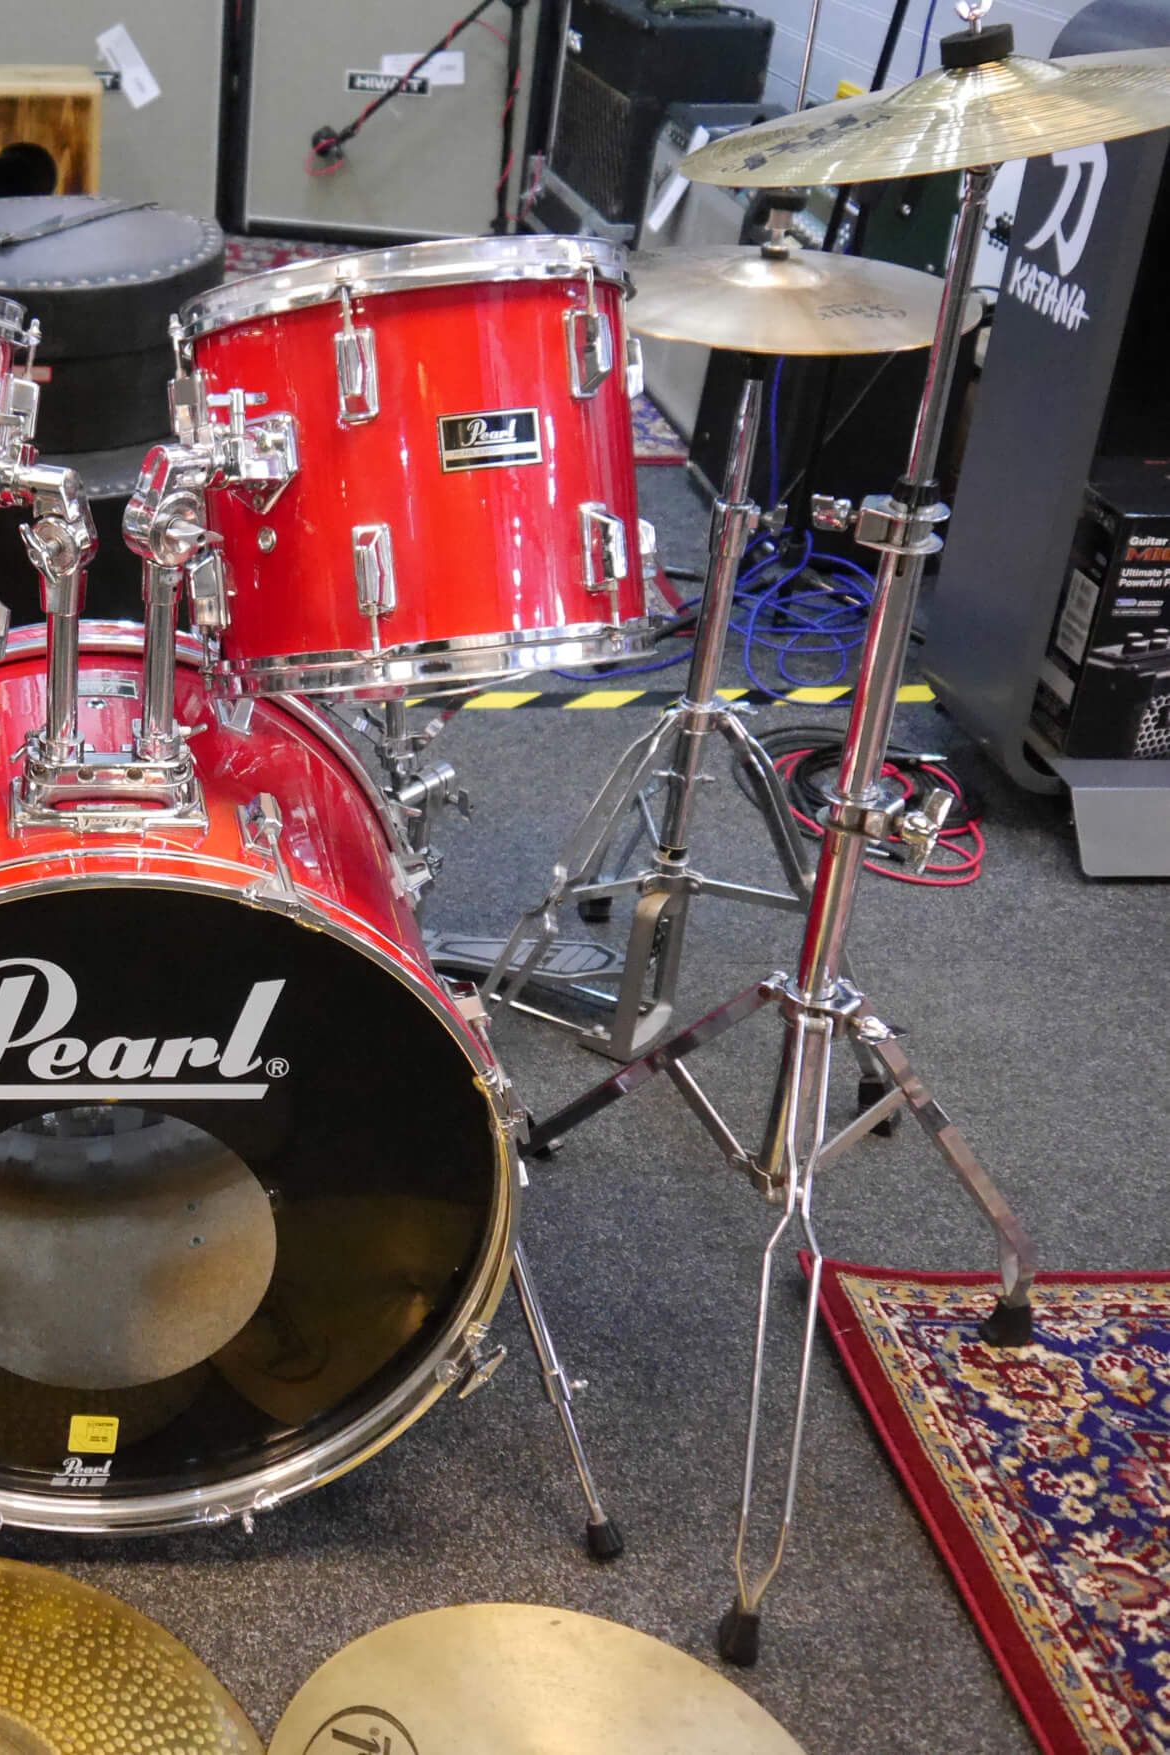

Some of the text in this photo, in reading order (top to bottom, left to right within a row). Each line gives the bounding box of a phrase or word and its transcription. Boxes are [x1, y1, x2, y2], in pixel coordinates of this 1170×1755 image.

[1008, 256, 1090, 332] KATANA
[460, 418, 517, 447] Pearl
[1129, 536, 1168, 546] Guitar
[1121, 568, 1162, 577] Ultimate
[1118, 578, 1163, 588] Powerful
[56, 1457, 112, 1477] Pearl
